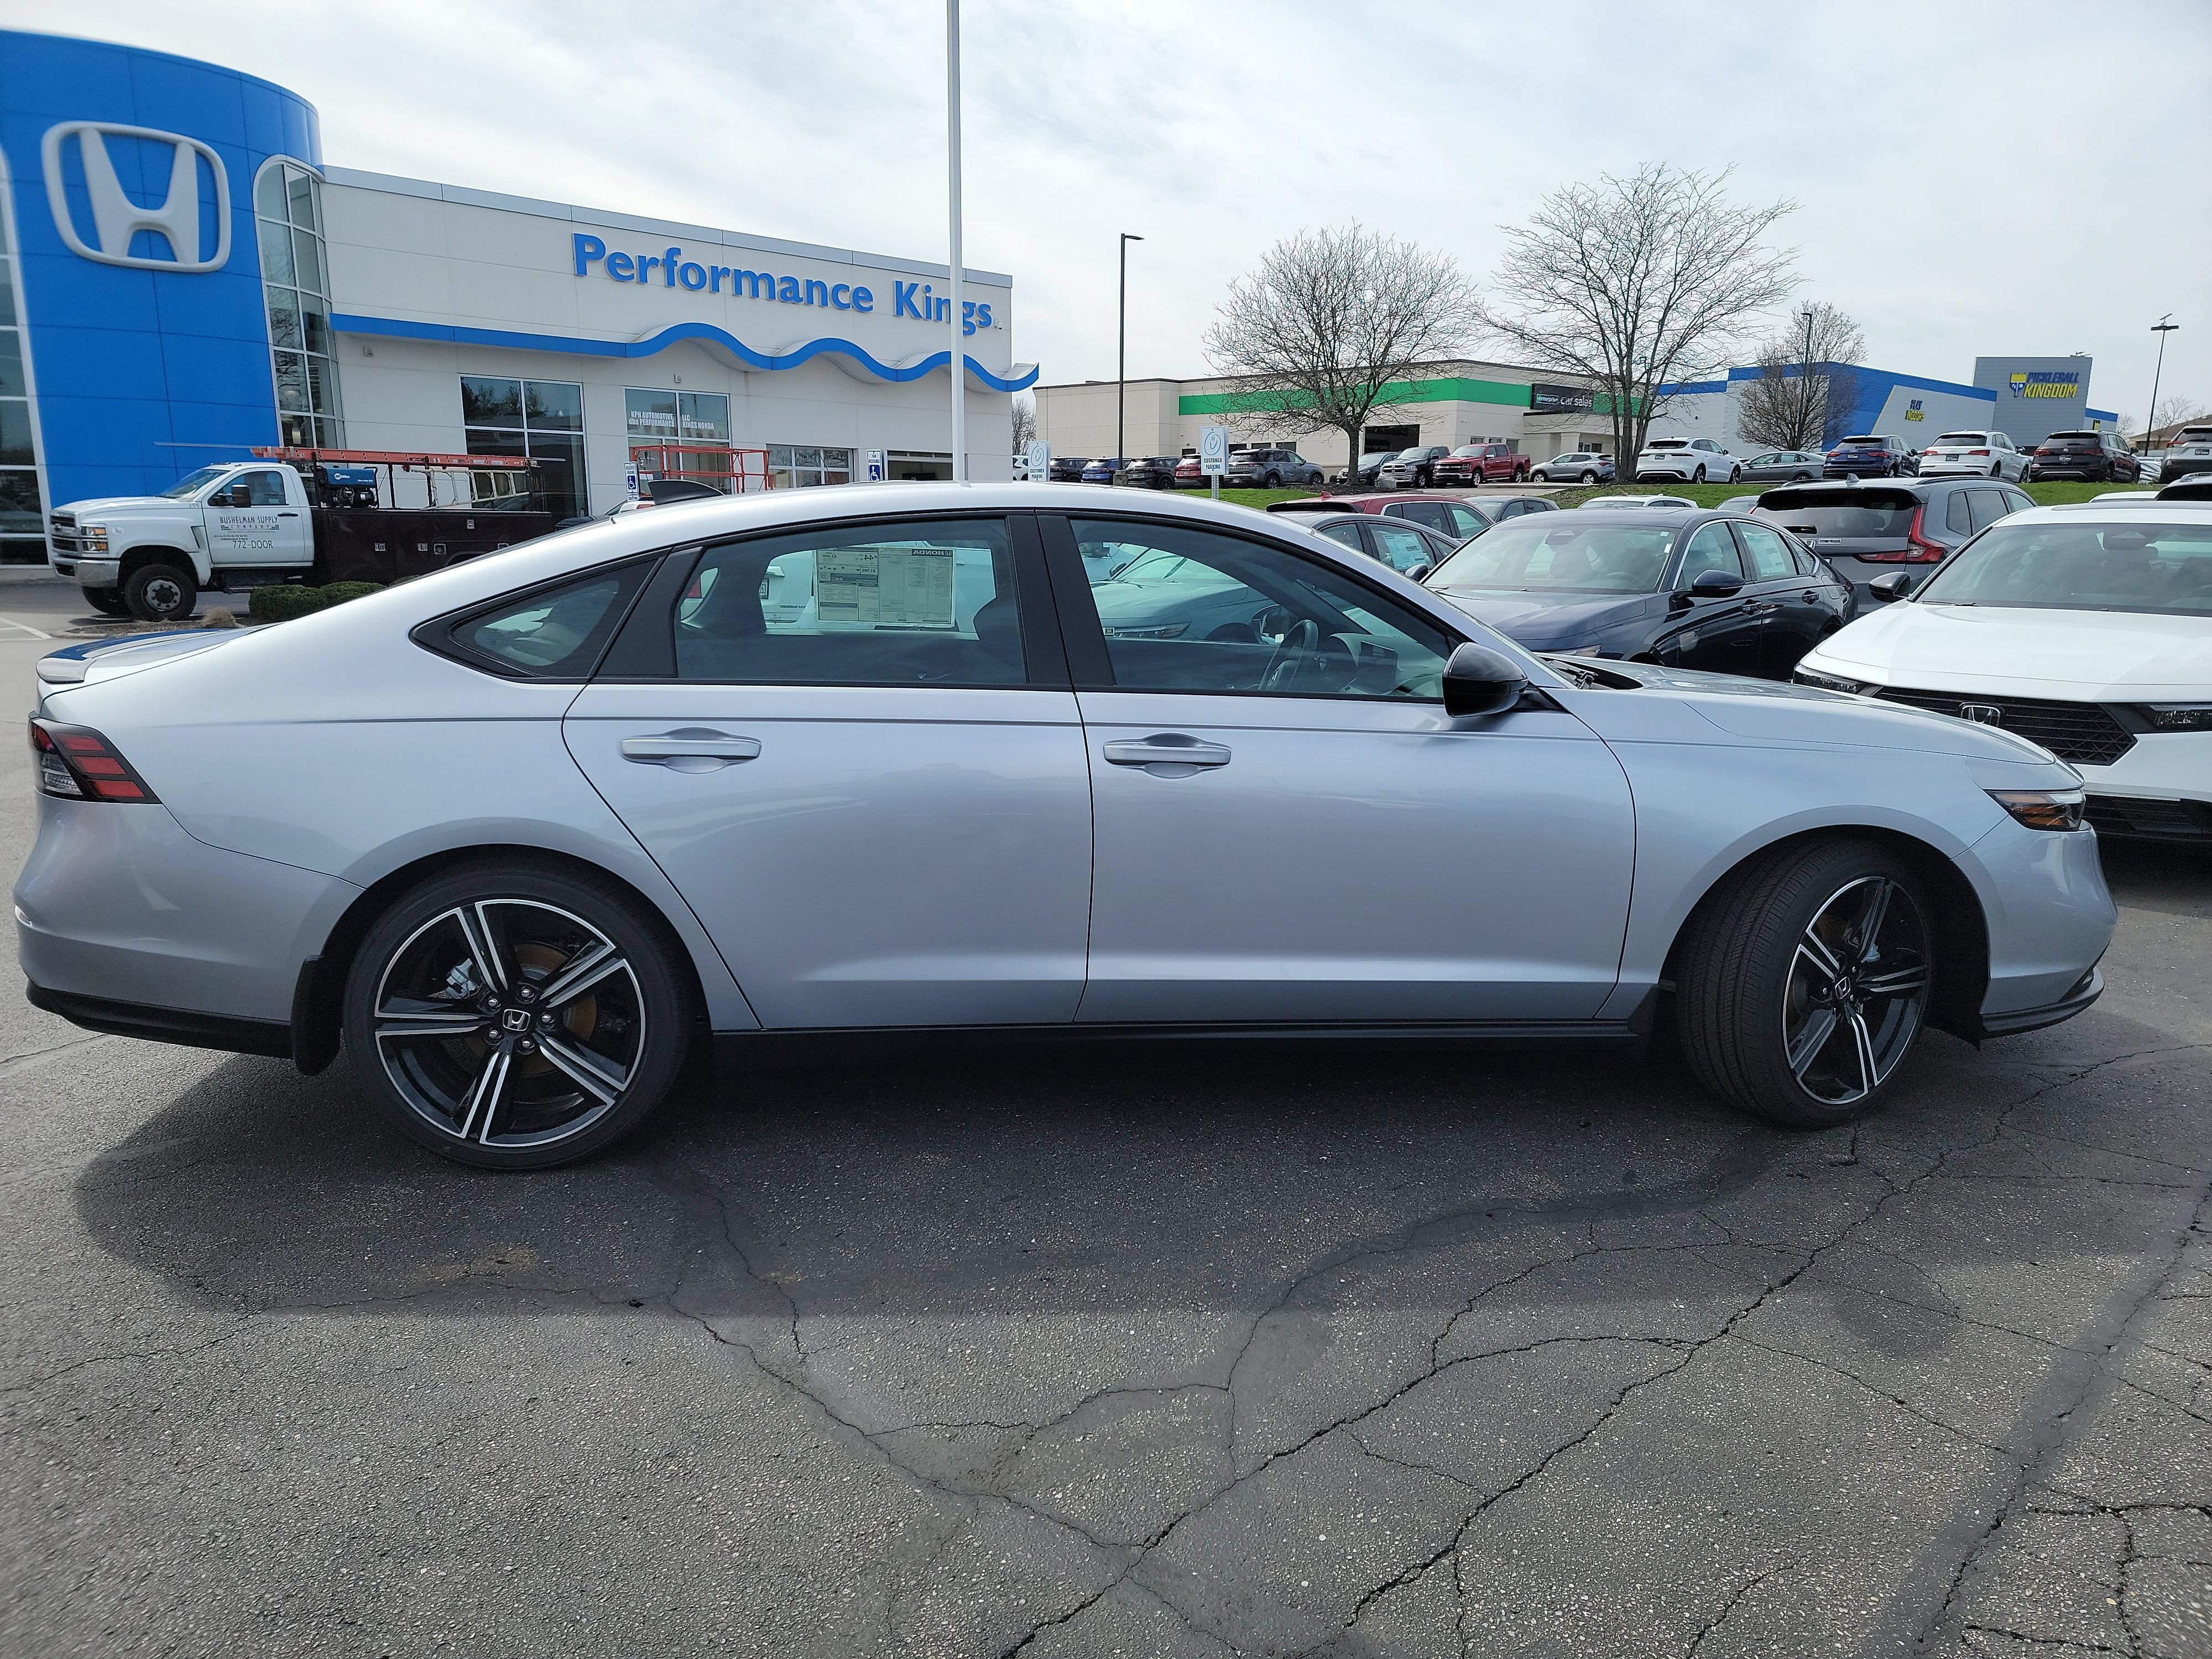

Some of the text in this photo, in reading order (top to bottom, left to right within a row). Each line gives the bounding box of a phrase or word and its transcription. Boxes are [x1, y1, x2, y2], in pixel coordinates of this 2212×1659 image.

[572, 233, 874, 312] Performance
[2027, 372, 2079, 383] PICKLEBALL
[2023, 384, 2078, 398] KINGDOM
[630, 410, 641, 419] KPH
[639, 418, 675, 427] PERFORMANCE
[232, 540, 273, 549] 772-DOOR
